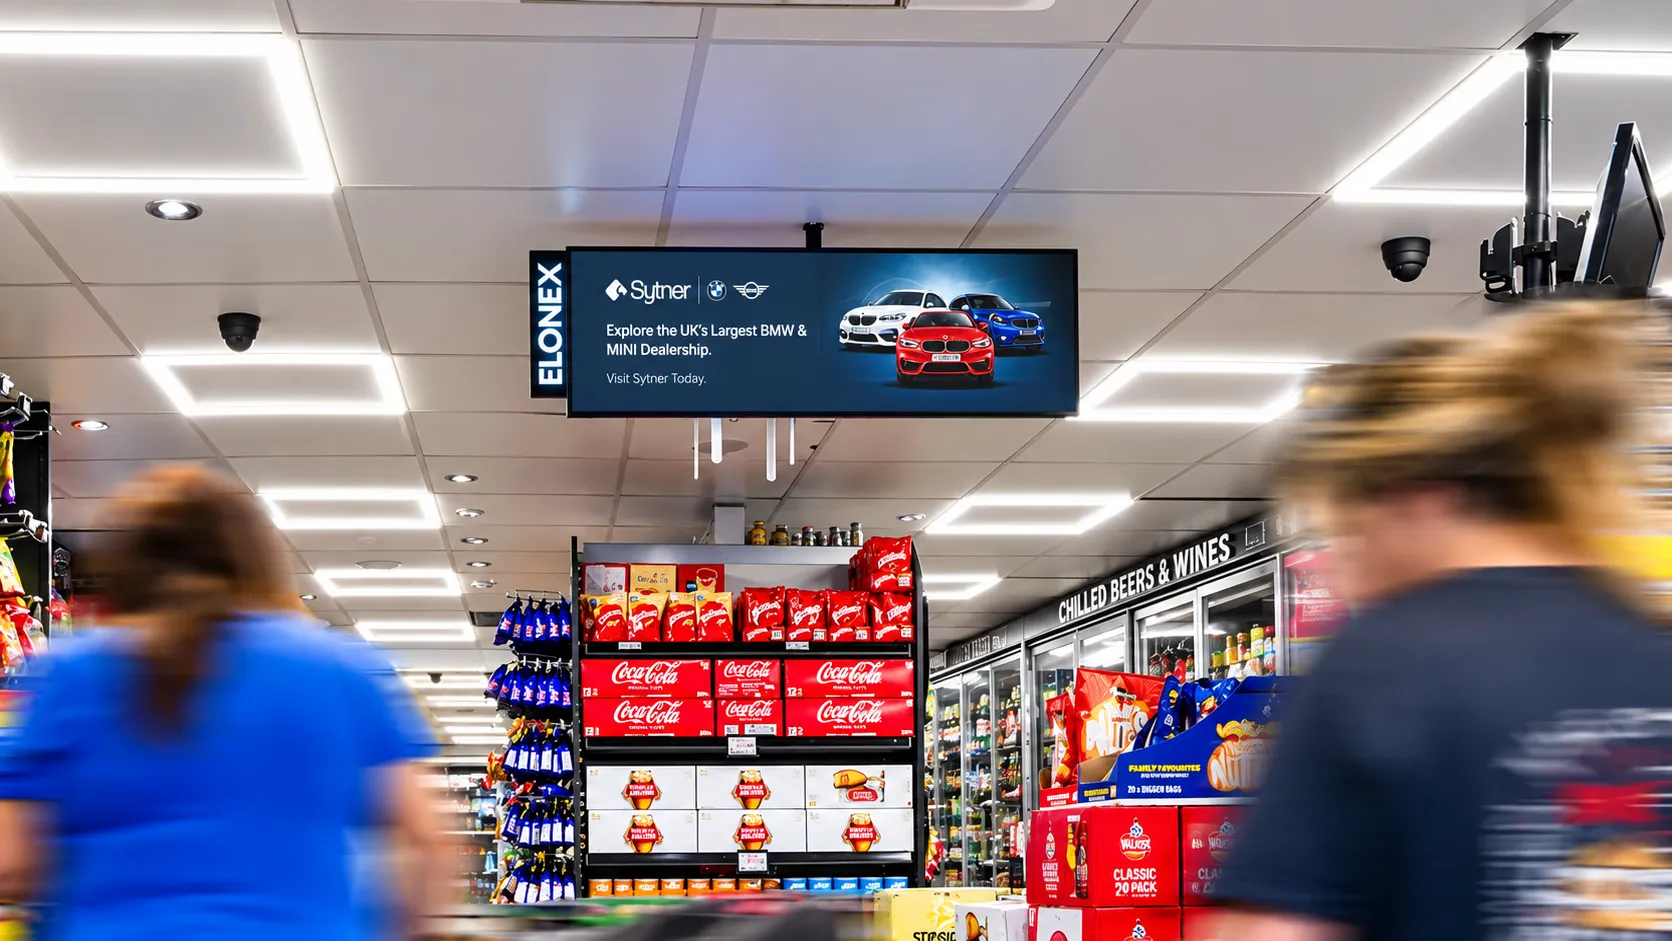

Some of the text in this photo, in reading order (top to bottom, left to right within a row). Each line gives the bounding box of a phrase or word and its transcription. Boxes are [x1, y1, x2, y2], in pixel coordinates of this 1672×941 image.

[630, 279, 691, 305] Sytner
[538, 262, 563, 385] ELONEX
[606, 324, 807, 339] Explore the UK's Largest BMW &
[606, 343, 712, 358] MINI Dealership.
[606, 372, 707, 387] Visit Sytner Today.
[1058, 533, 1231, 624] CHILLED BEERS & WINES
[1113, 867, 1157, 881] CLASSIC
[1114, 881, 1157, 897] 20 PACK
